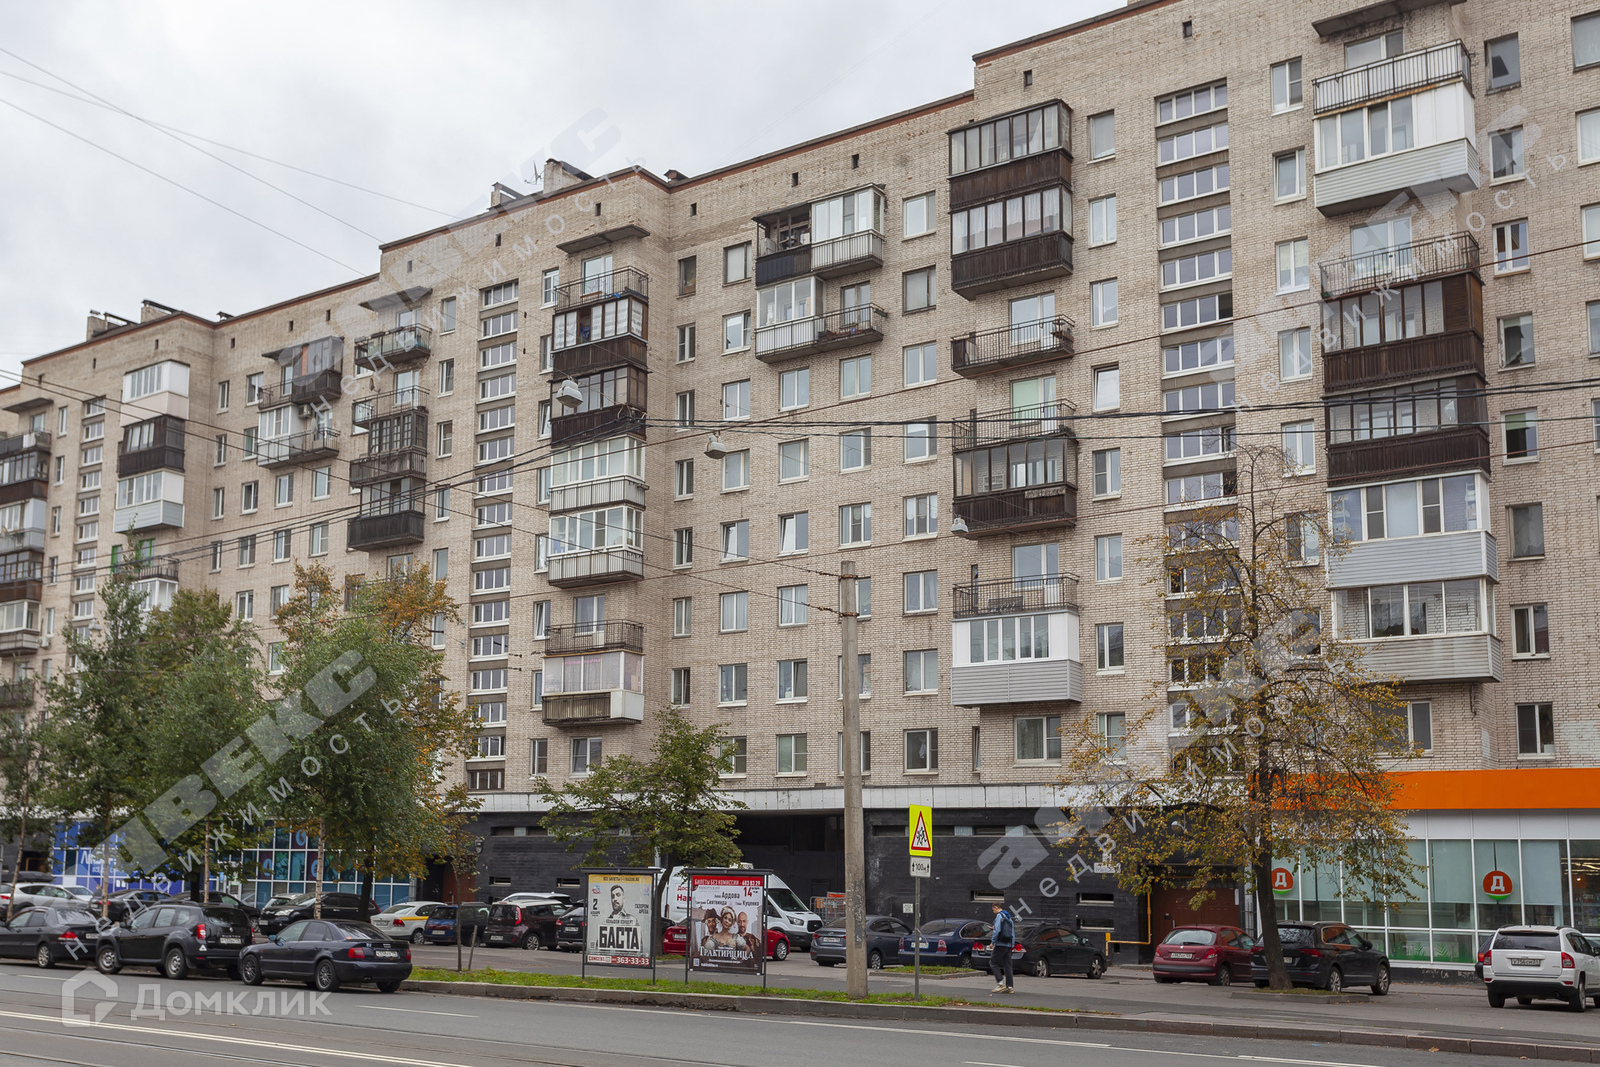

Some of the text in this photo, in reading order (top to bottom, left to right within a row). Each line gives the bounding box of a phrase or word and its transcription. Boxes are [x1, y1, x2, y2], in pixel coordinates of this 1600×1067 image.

[1275, 872, 1287, 887] Д
[1491, 876, 1505, 892] Д
[722, 892, 740, 900] Ардова
[743, 886, 752, 897] 14
[593, 898, 598, 910] 2
[599, 926, 639, 950] БАСТА
